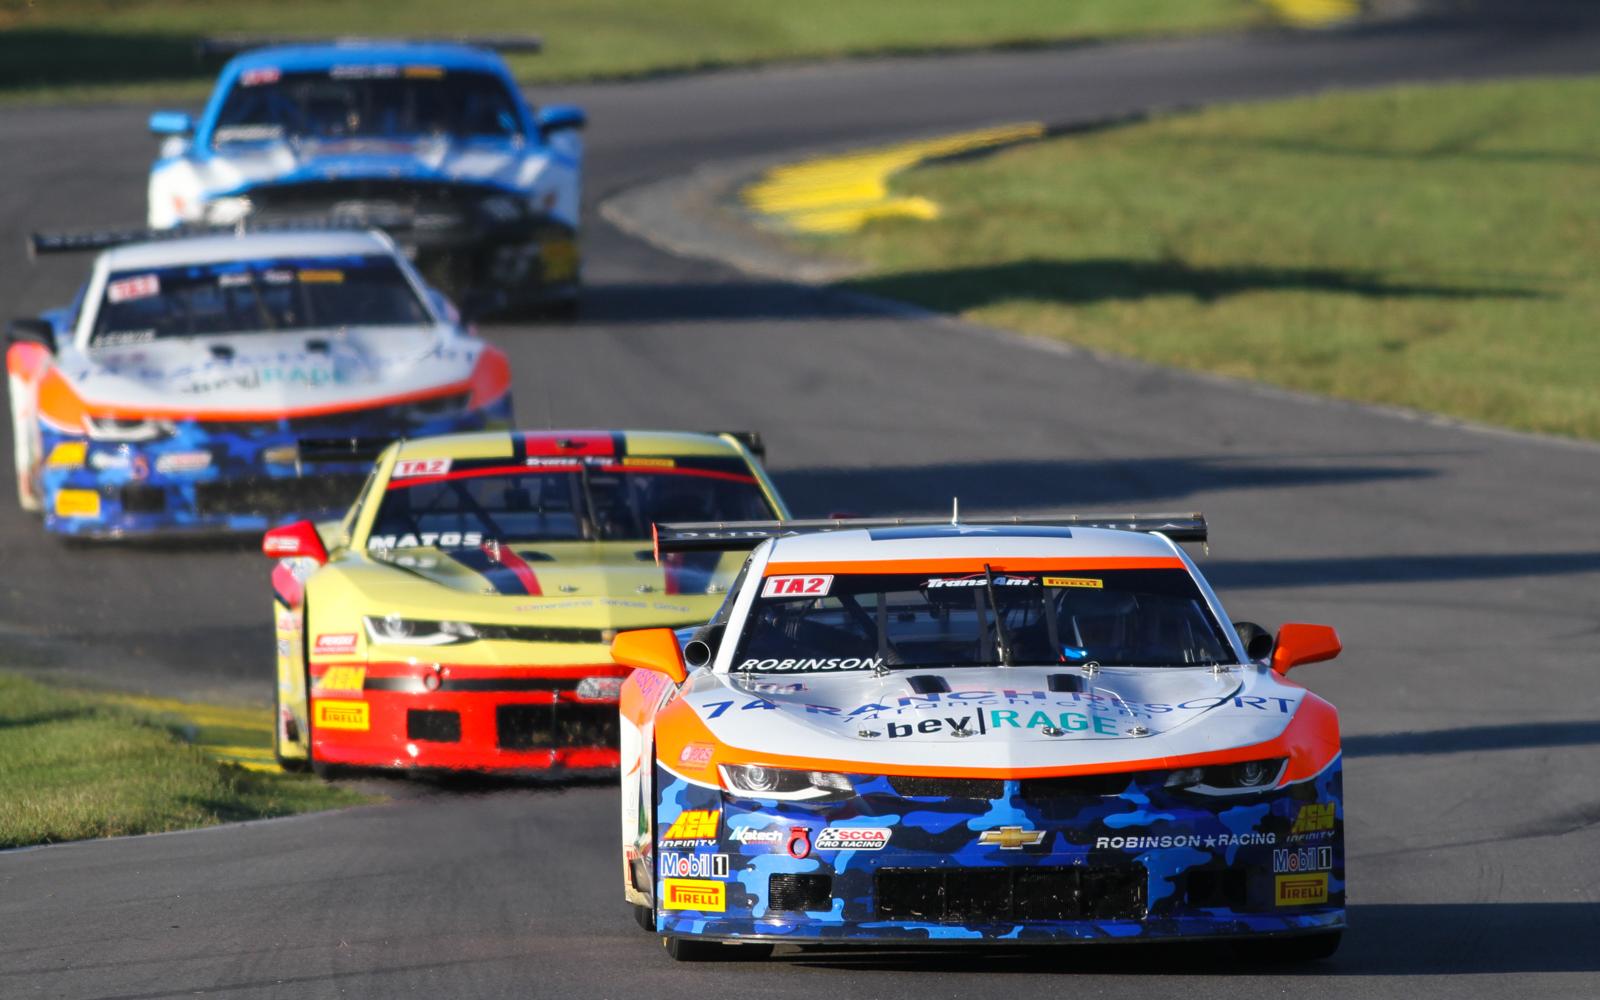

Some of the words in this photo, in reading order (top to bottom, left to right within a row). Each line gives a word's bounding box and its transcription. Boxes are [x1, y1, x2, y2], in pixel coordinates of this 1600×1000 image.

[402, 461, 444, 474] TA2
[369, 532, 482, 550] MATOS
[773, 578, 825, 594] TA2
[927, 577, 988, 588] Trans
[738, 658, 883, 671] ROBINSON
[319, 666, 367, 691] AEM
[702, 699, 781, 719] 74
[804, 690, 1046, 717] RANCH
[1071, 692, 1291, 715] RESORT
[321, 706, 363, 723] PIRELLI
[663, 809, 720, 840] AEM
[1291, 801, 1335, 833] AEM
[657, 839, 717, 849] INFINITY
[728, 826, 784, 846] Katech
[839, 831, 885, 841] SCCA
[1096, 834, 1201, 849] ROBINSON
[1217, 832, 1276, 846] RACING
[1286, 830, 1336, 843] INFINITY
[819, 841, 840, 849] PRO
[841, 841, 884, 849] RACING
[660, 852, 710, 877] Mobil
[713, 855, 726, 876] 1
[1272, 847, 1316, 873] Mobil
[670, 884, 720, 906] PIRELLI
[1280, 879, 1324, 899] PIRELLI
